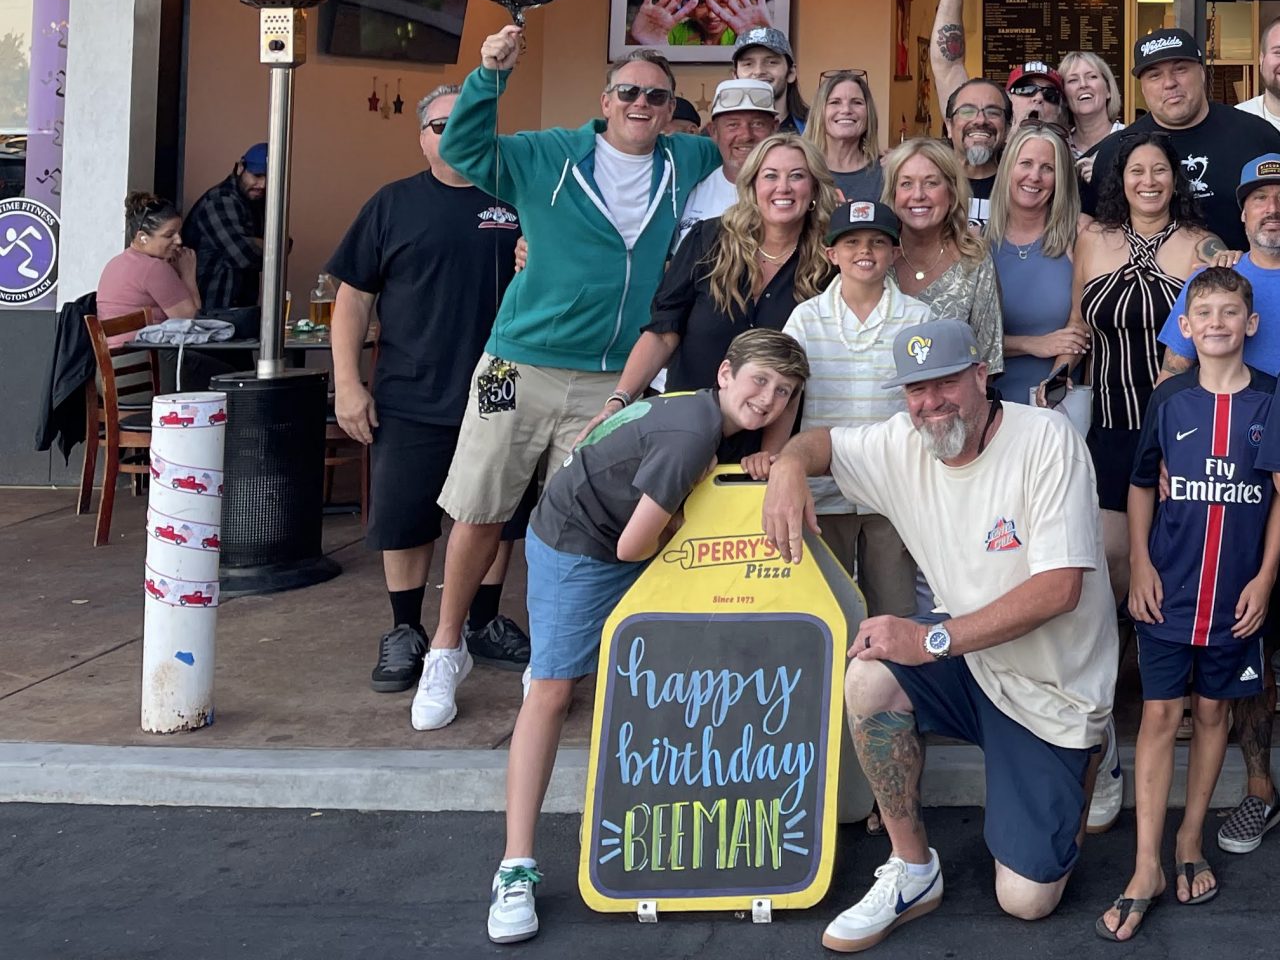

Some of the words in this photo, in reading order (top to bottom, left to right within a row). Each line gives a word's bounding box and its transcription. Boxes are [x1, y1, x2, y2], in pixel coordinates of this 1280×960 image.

[1141, 36, 1183, 57] Westside
[22, 202, 56, 227] FITNESS
[28, 278, 52, 298] BEACH
[490, 377, 515, 402] 50
[1205, 458, 1236, 480] Fly
[1170, 476, 1263, 504] Emirates
[697, 536, 777, 563] PERRY'S
[744, 563, 791, 579] Pizza
[712, 595, 734, 604] Since
[736, 595, 755, 604] 1973
[617, 637, 802, 735] happy
[616, 721, 815, 814] birthday
[624, 798, 782, 872] BEEMAN
